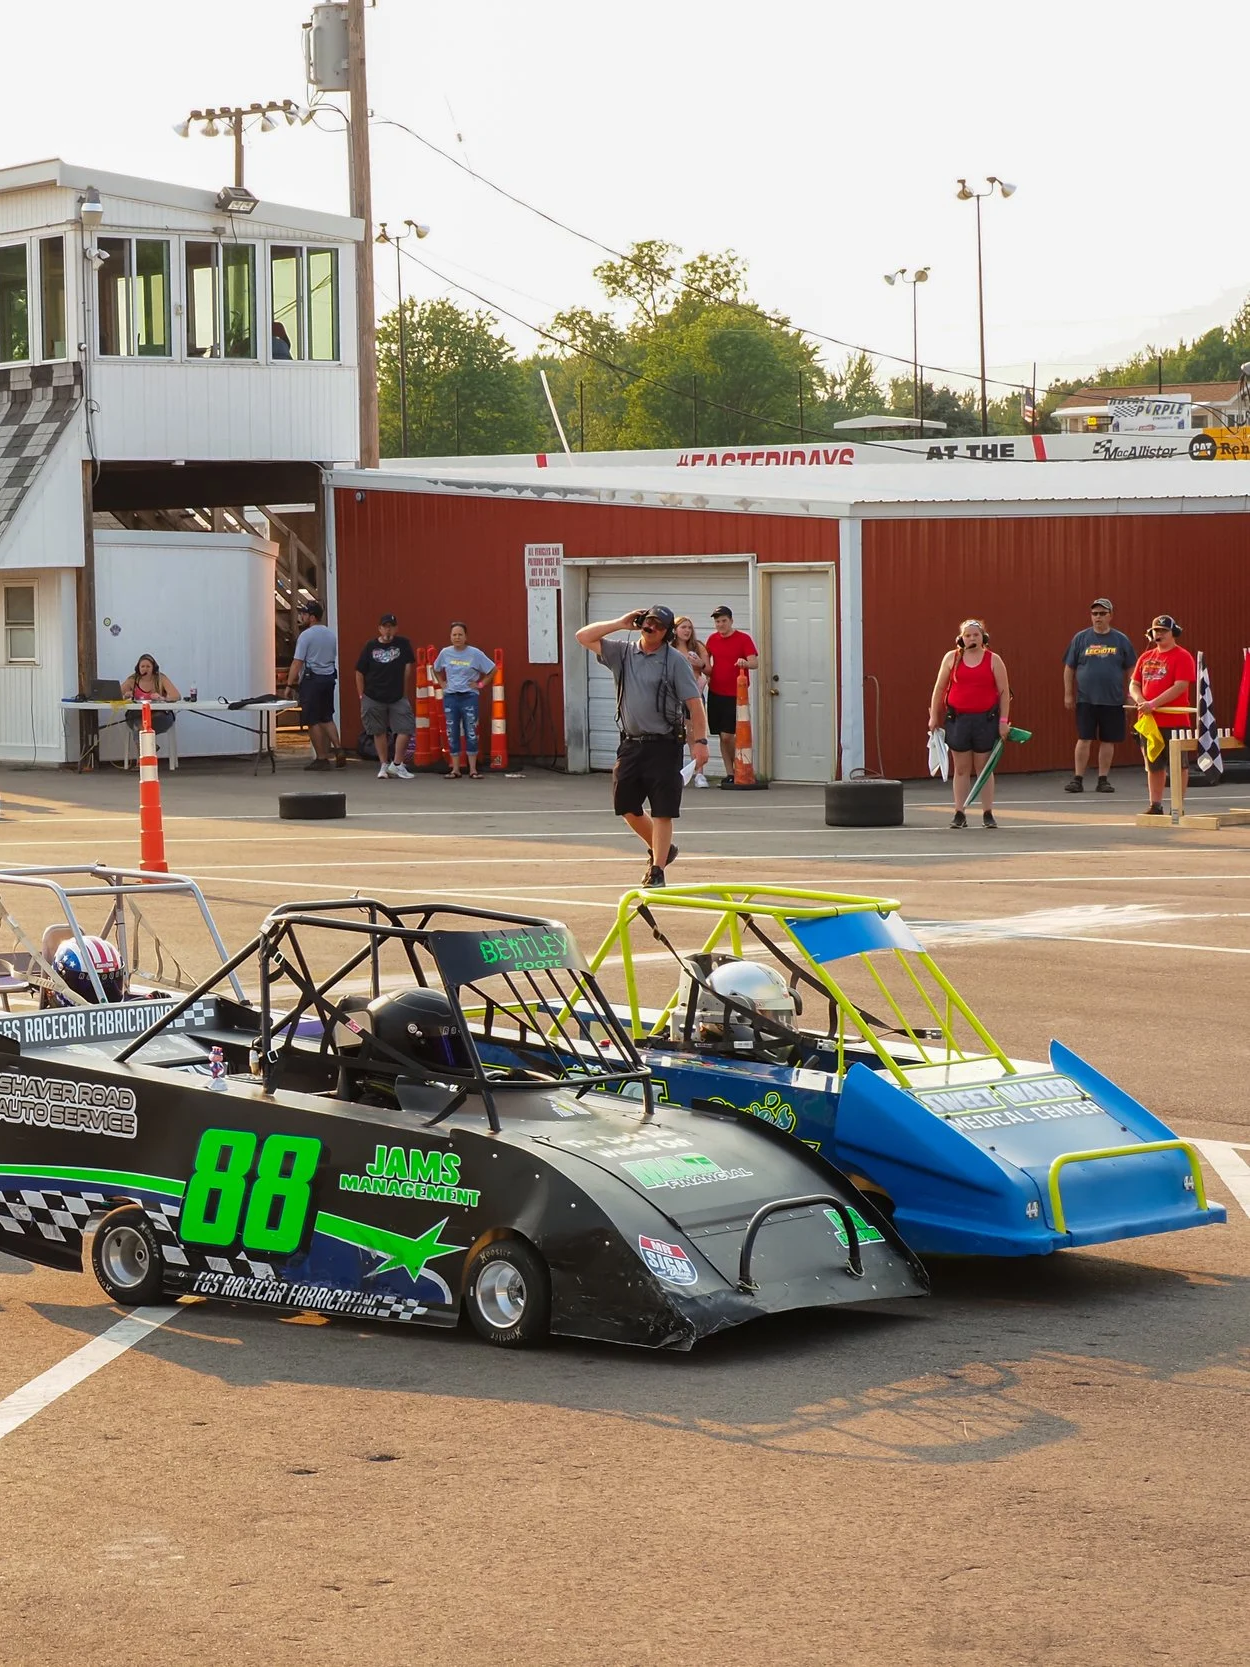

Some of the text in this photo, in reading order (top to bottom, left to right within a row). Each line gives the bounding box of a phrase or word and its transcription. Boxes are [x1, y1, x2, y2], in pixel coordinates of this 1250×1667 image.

[1135, 404, 1184, 416] PURPLE
[927, 444, 1015, 460] AT THE
[1104, 444, 1178, 460] MacAllister
[1192, 442, 1212, 456] CAT
[480, 934, 568, 964] BENTLEY
[514, 960, 563, 970] FOOTE
[25, 1012, 86, 1042] RACECAR
[79, 1084, 134, 1110] ROAD
[919, 1078, 1085, 1114] SWEET WATER
[50, 1104, 136, 1134] SERVICE
[949, 1101, 1104, 1131] MEDICAL CENTER
[366, 1144, 461, 1186] JAMS
[180, 1128, 323, 1254] 88
[340, 1174, 480, 1207] MANAGEMENT
[668, 1168, 753, 1190] FINANCIAL
[1026, 1201, 1038, 1218] 44
[480, 1248, 512, 1264] Hoosier
[646, 1250, 691, 1273] SIGN
[221, 1275, 288, 1304] RACECAR
[287, 1284, 382, 1316] FABRICATING
